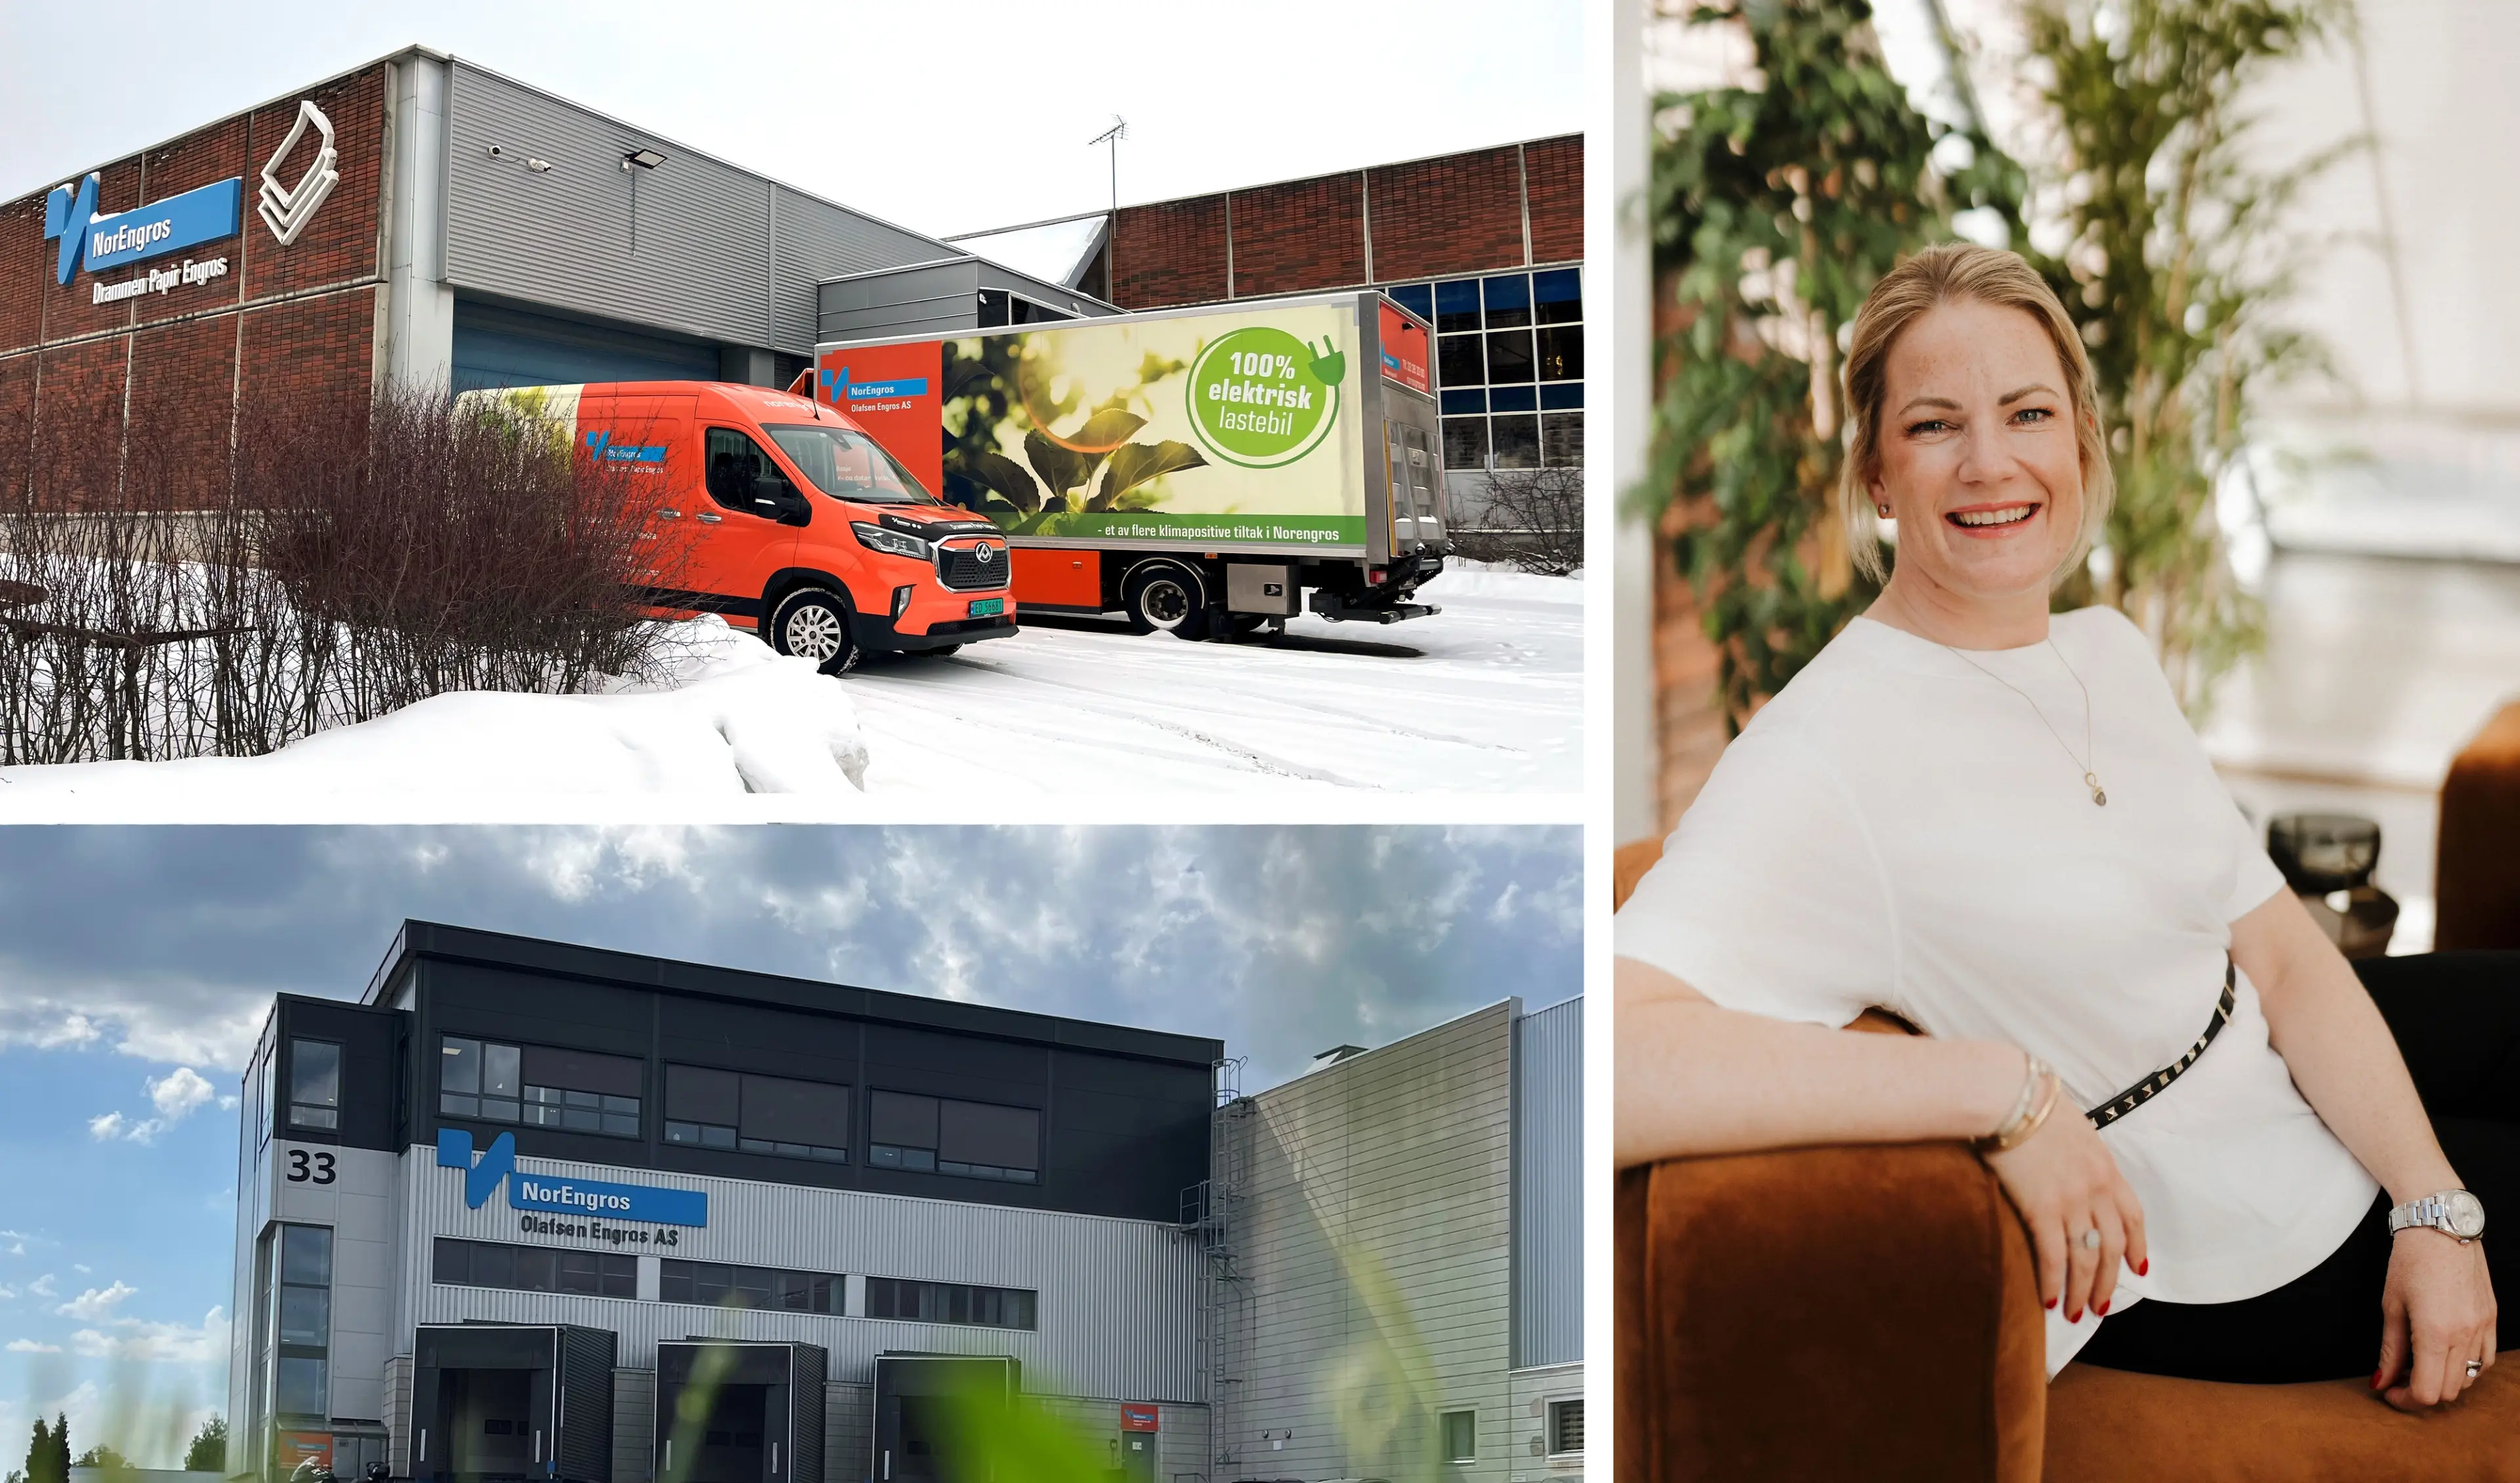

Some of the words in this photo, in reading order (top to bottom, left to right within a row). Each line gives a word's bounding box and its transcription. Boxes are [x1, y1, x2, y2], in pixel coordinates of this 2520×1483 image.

[93, 219, 171, 258] NorEngros
[93, 278, 148, 304] Drammen
[148, 264, 181, 295] Papir
[182, 257, 228, 285] Engros
[1230, 352, 1295, 379] 100%
[851, 386, 894, 396] NorEngros
[1208, 378, 1312, 409] elektrisk
[851, 403, 876, 413] Olafsen
[877, 402, 900, 412] Engros
[1219, 406, 1293, 436] lastebil
[1105, 526, 1115, 536] et
[1118, 527, 1129, 536] av
[1131, 524, 1156, 536] flere
[1159, 525, 1231, 539] klimapositive
[1233, 526, 1263, 539] tiltak
[1266, 526, 1270, 539] i
[1273, 526, 1339, 543] Norengros
[975, 602, 982, 614] ED
[985, 600, 1001, 612] 56681
[287, 1150, 336, 1184] 33
[522, 1182, 631, 1211] NorEngros
[521, 1215, 587, 1238] Olafsen
[592, 1222, 648, 1245] Engros
[654, 1228, 679, 1246] AS
